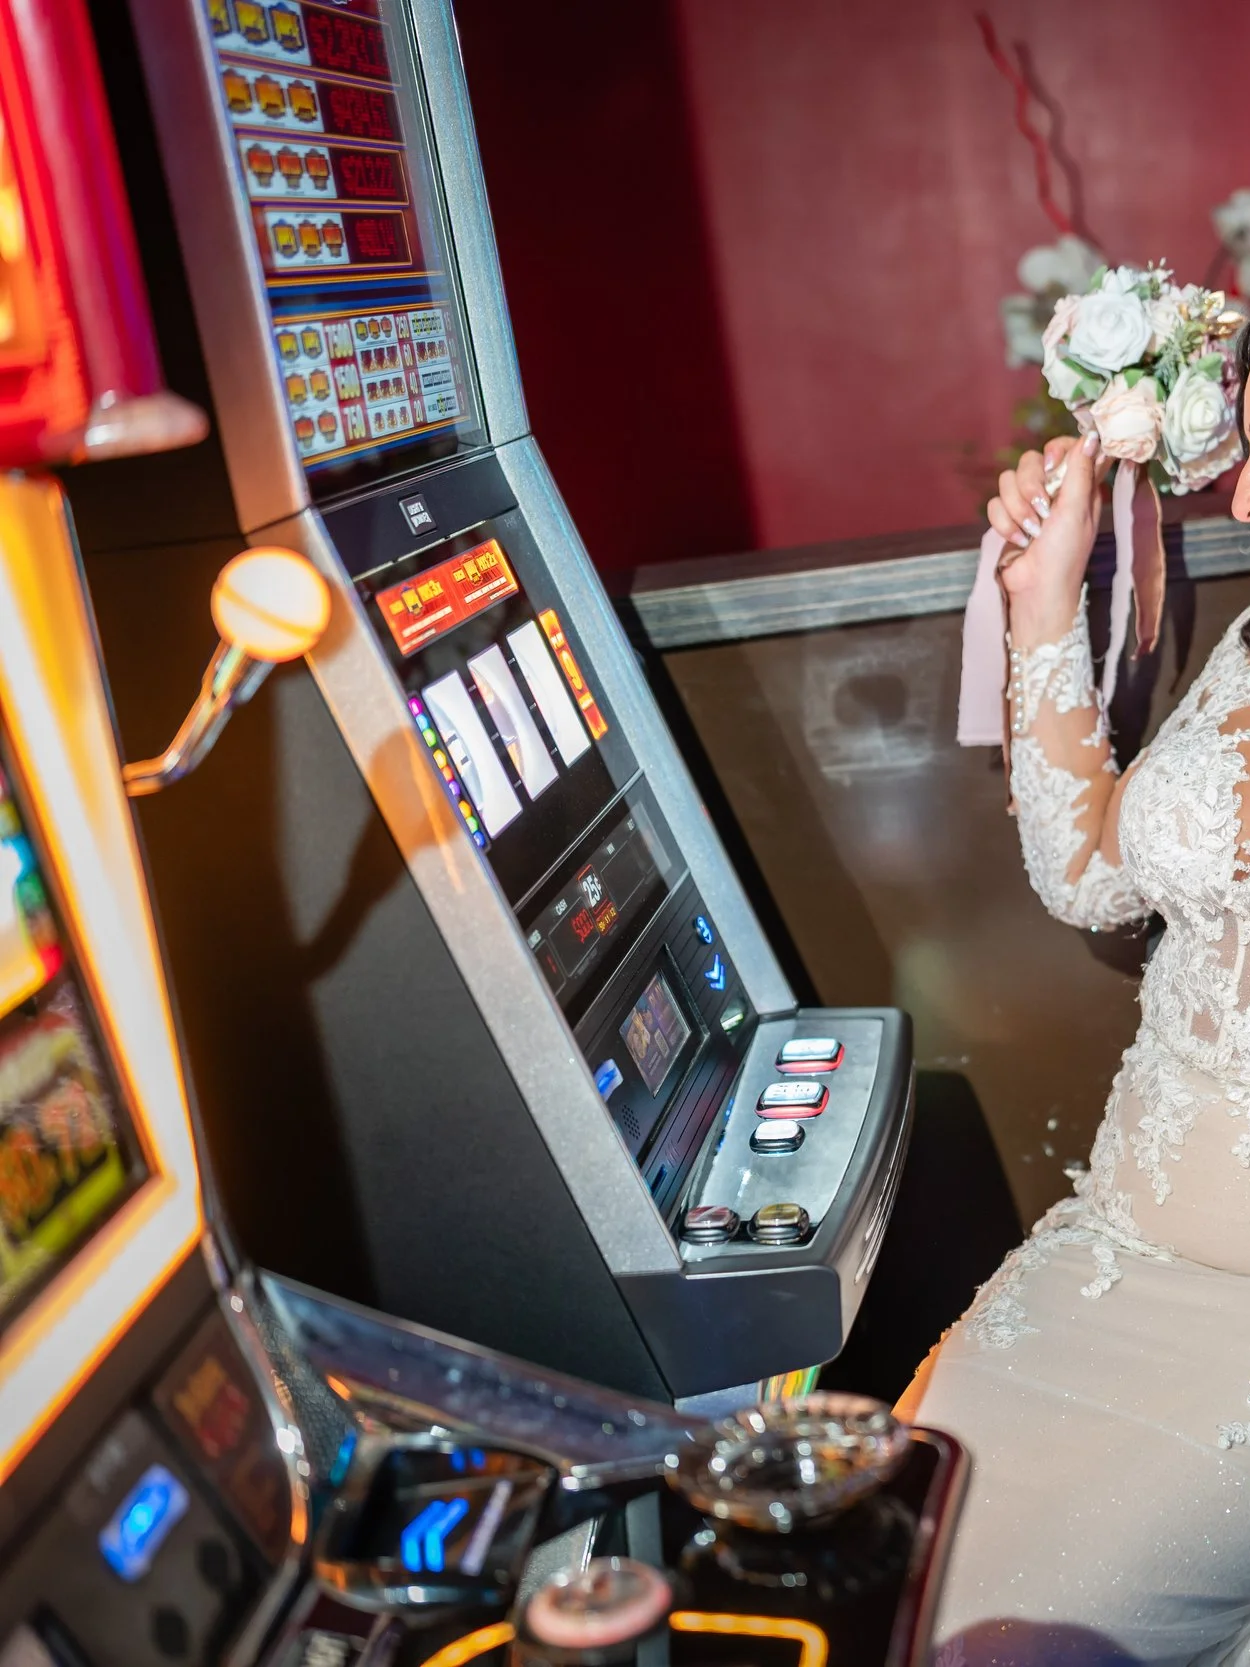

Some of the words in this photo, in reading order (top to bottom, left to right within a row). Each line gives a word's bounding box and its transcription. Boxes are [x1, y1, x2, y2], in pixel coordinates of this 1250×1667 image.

[325, 322, 354, 360] 7500
[395, 314, 410, 338] 250
[343, 403, 367, 440] 750
[561, 649, 583, 691] 9
[555, 898, 568, 916] CASH
[582, 873, 602, 908] 25¢
